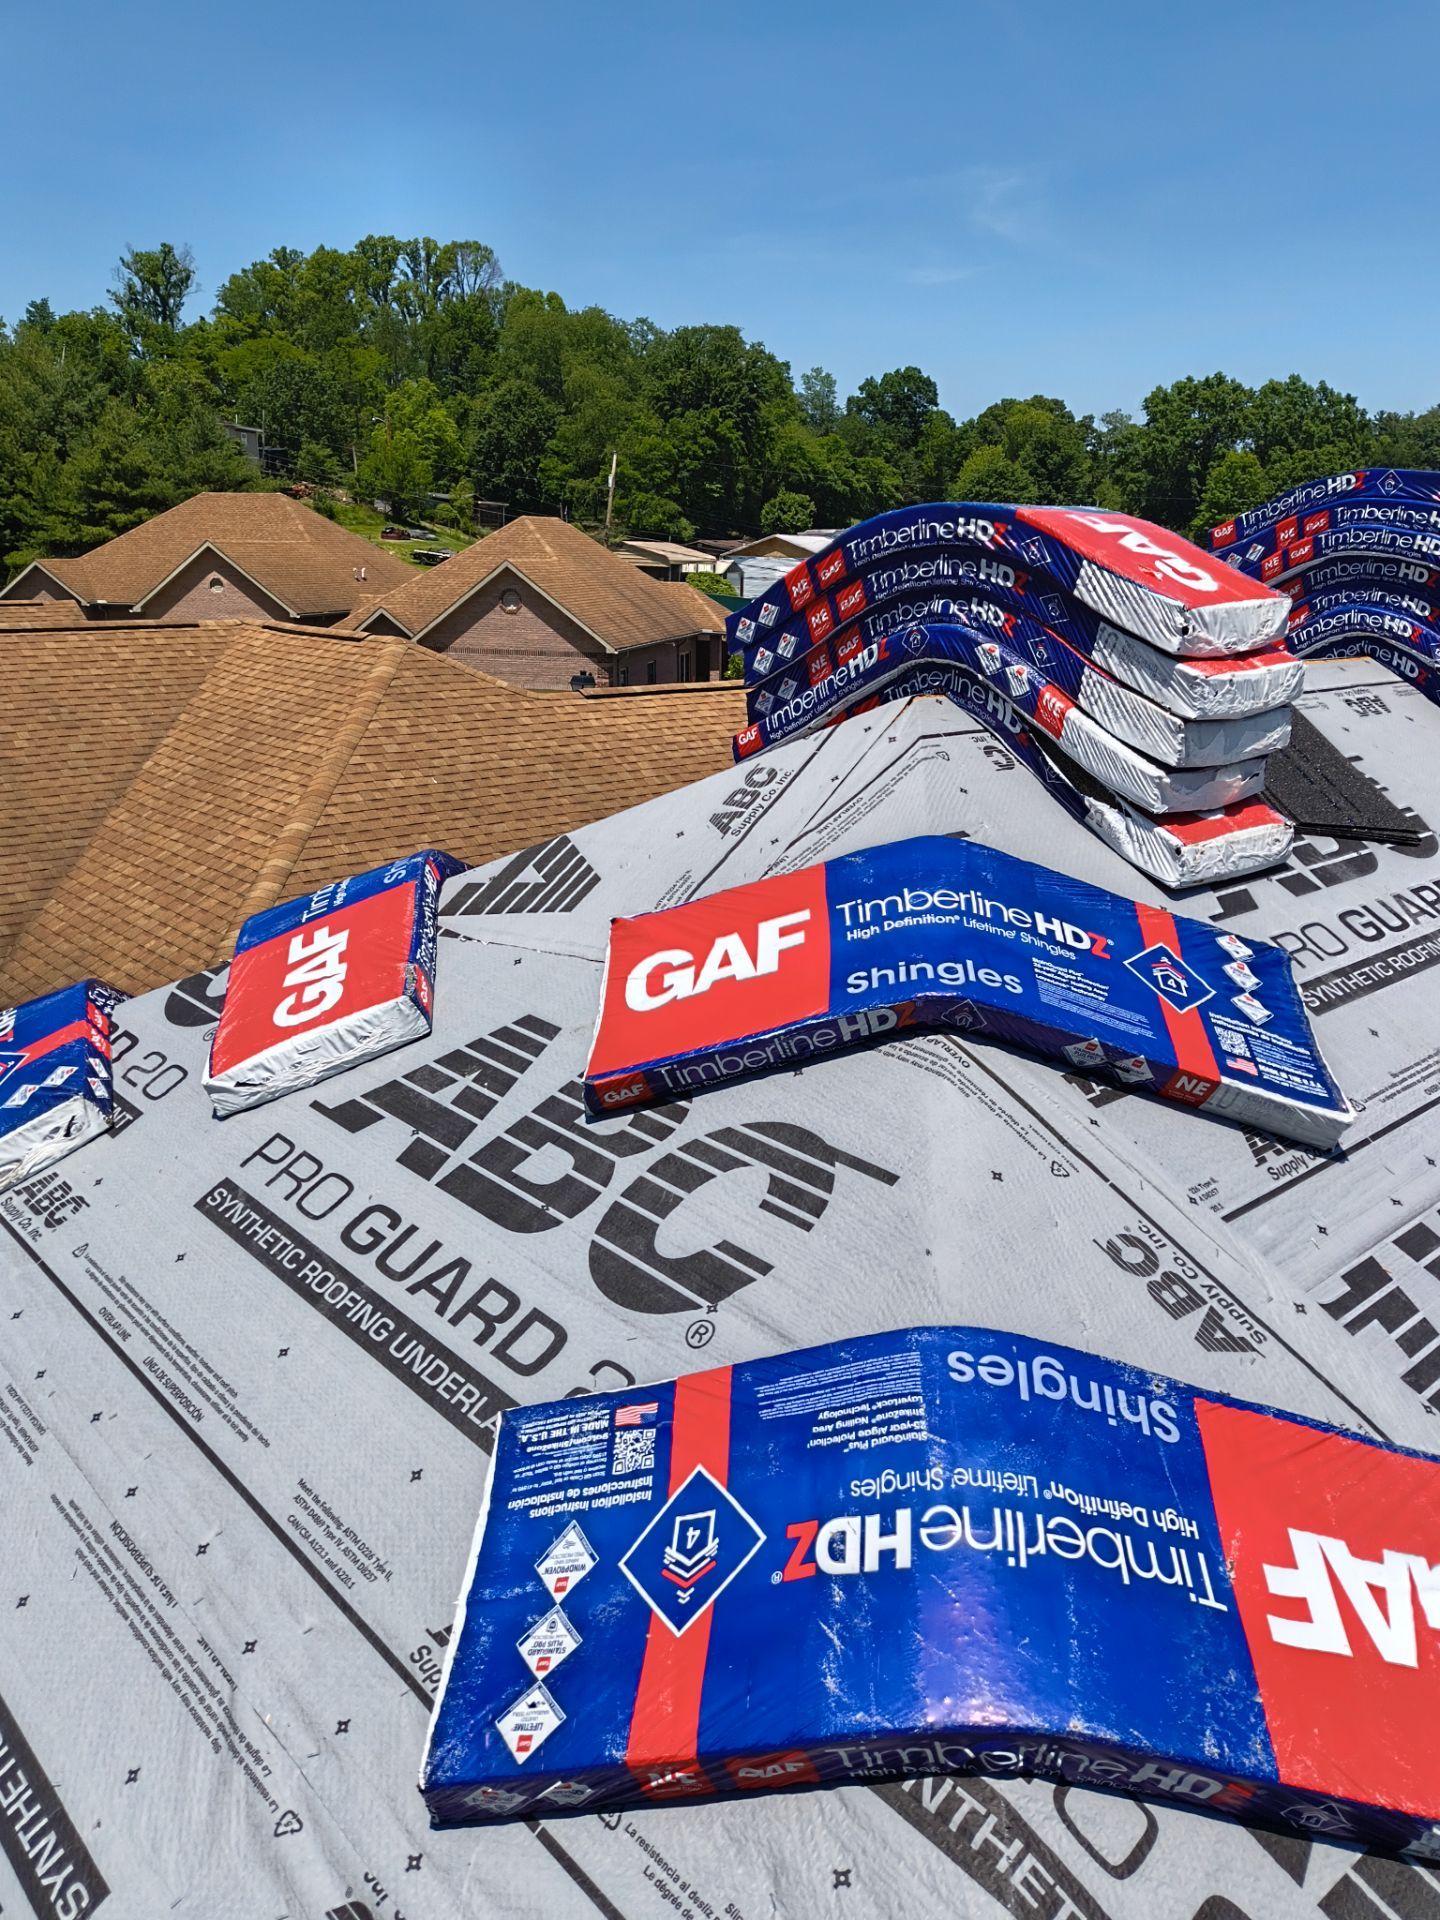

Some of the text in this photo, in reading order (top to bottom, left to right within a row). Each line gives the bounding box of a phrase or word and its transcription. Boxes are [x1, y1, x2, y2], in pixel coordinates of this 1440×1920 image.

[821, 559, 844, 581] GAF
[837, 634, 860, 657] GAF
[810, 653, 828, 674] NE
[738, 727, 759, 745] GAF
[768, 726, 786, 741] High
[709, 763, 779, 840] ABC
[730, 803, 765, 837] Supply
[1270, 880, 1440, 968] RO GUAR
[847, 925, 880, 941] High
[1020, 931, 1077, 960] Shingles
[624, 907, 811, 1013] GAF
[1303, 938, 1440, 1008] SYNTHETIC ROOFIN
[272, 925, 349, 1028] GAF
[847, 960, 1024, 994] shingles
[909, 1058, 924, 1070] may
[925, 1037, 971, 1068] OVERLAP
[121, 1051, 188, 1101] 20
[954, 1085, 972, 1099] Slip
[1175, 1075, 1212, 1097] NE
[604, 1084, 645, 1104] GAF
[310, 1014, 901, 1314] ABC
[1267, 1154, 1310, 1182] Supply
[12, 1171, 90, 1231] ABC
[240, 1133, 354, 1221] PRO
[340, 1204, 569, 1377] GUARD
[1173, 1251, 1199, 1280] Co.
[1092, 1233, 1266, 1359] ABC
[96, 1305, 132, 1342] OVERLAP LINE
[206, 1187, 306, 1271] SYNTHETIC
[297, 1259, 397, 1343] ROOFING
[388, 1331, 498, 1441] UNDERLA
[1200, 1283, 1268, 1346] Supply
[154, 1369, 167, 1383] DE
[816, 1402, 871, 1420] Technology
[947, 1350, 1181, 1443] shingles
[549, 1426, 567, 1437] THE
[569, 1424, 580, 1434] IN
[580, 1419, 609, 1432] MADE
[811, 1422, 834, 1434] Area
[834, 1415, 869, 1429] Nailing
[856, 1424, 889, 1439] Algae
[887, 1417, 927, 1435] 25-year
[869, 1428, 928, 1449] StainGuard
[565, 1487, 581, 1498] de
[580, 1473, 654, 1499] Instrucciones
[590, 1487, 653, 1510] Installation
[850, 1467, 945, 1500] Shingles
[291, 1492, 311, 1512] ASTM
[320, 1524, 338, 1542] Type
[340, 1545, 361, 1566] ASTM
[355, 1561, 378, 1584] D8257
[296, 1477, 315, 1497] Meets
[310, 1492, 323, 1506] the
[341, 1525, 361, 1546] ASTM
[357, 1541, 375, 1560] D226
[369, 1556, 388, 1575] Type
[1152, 1508, 1200, 1541] High
[285, 1513, 312, 1542] CAN/CSA
[323, 1555, 338, 1571] and
[1262, 1528, 1440, 1670] AF
[624, 1822, 714, 1920] La resistencia al desliz
[642, 1865, 656, 1882] Le
[655, 1876, 682, 1910] dégrée
